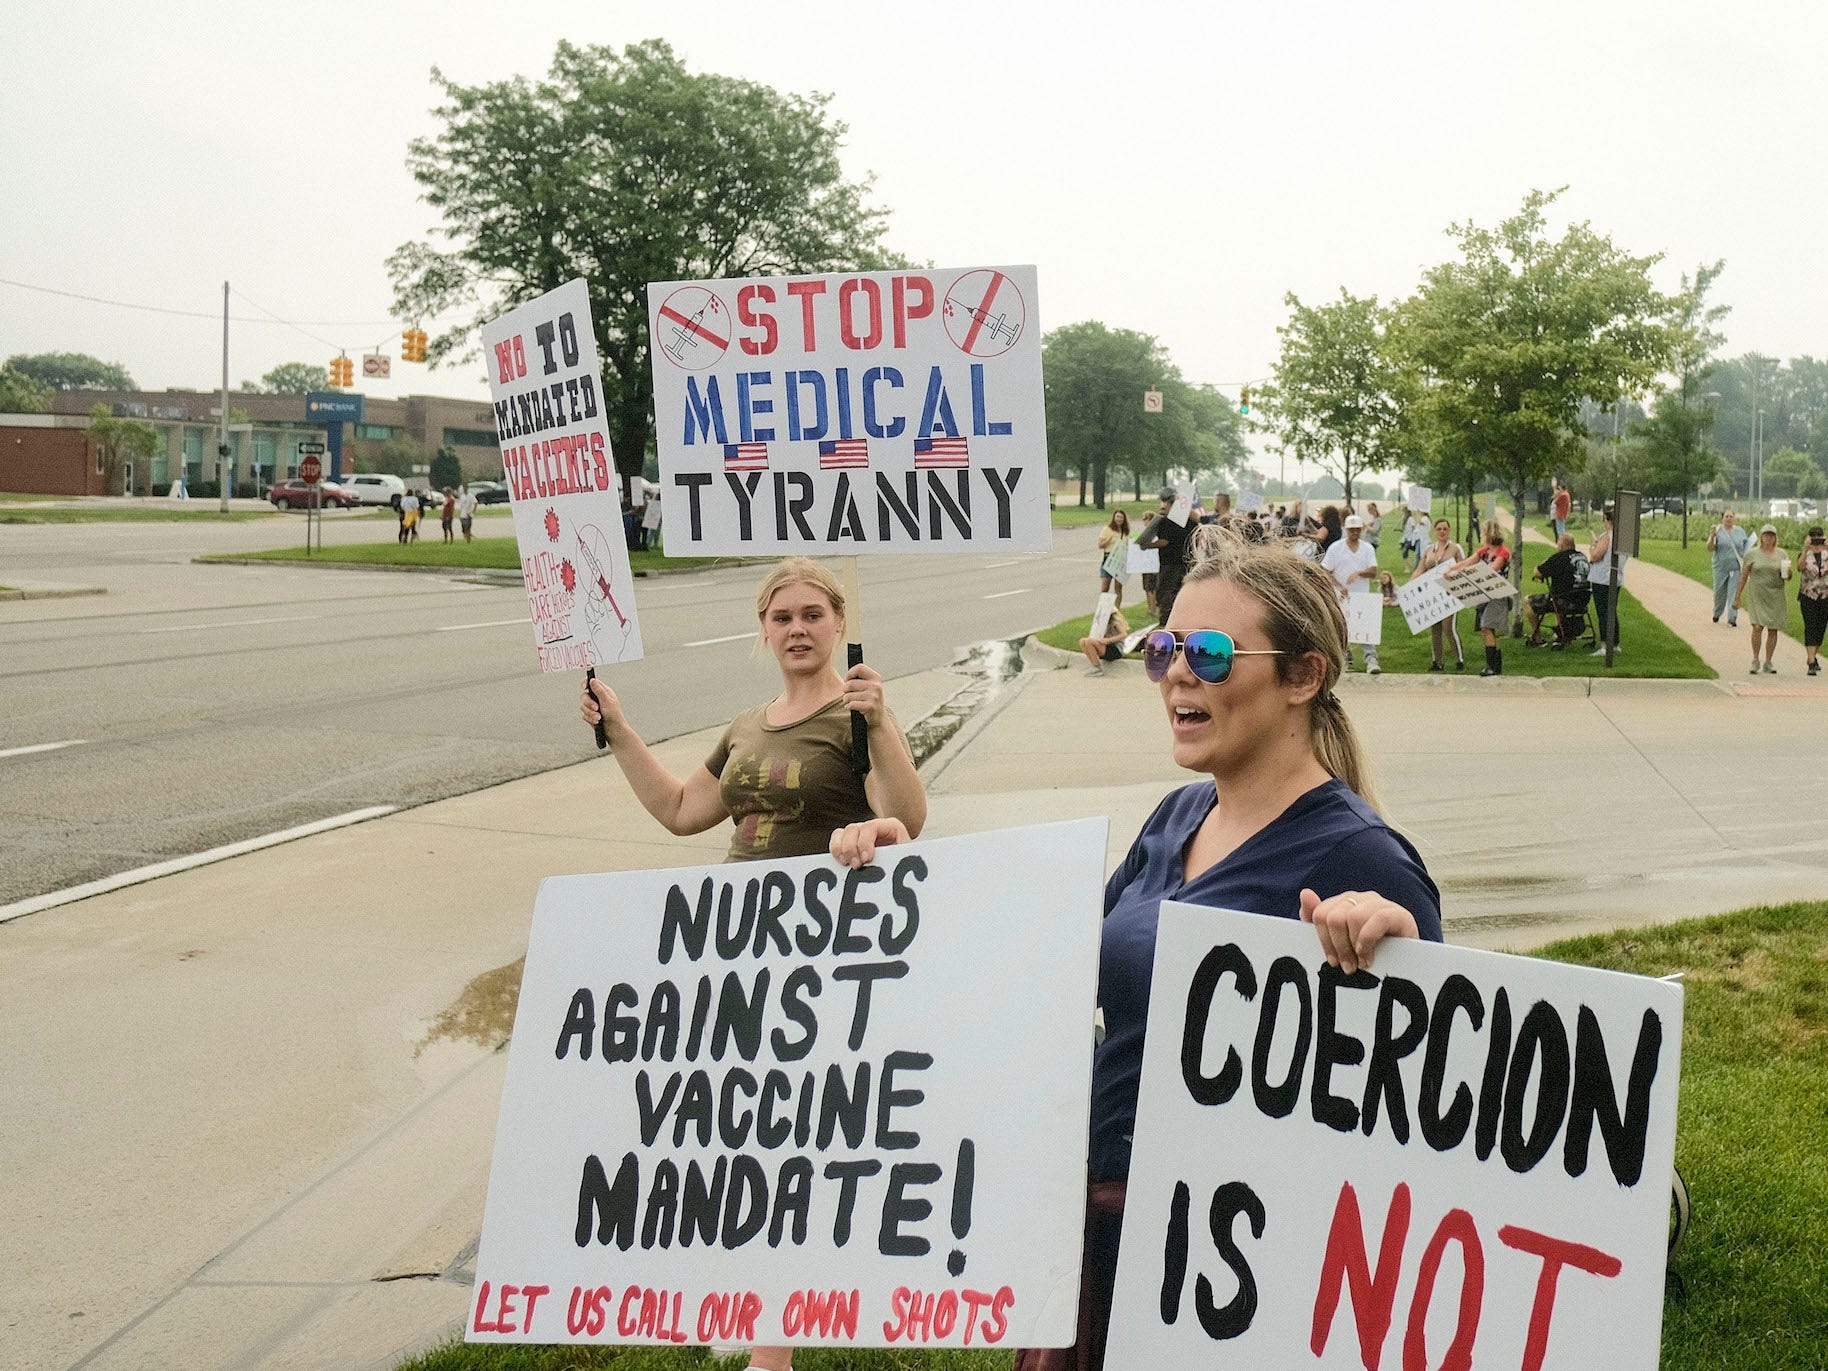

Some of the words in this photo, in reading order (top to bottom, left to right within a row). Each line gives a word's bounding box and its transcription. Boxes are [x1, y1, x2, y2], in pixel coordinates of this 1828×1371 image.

[495, 334, 526, 384] NO
[535, 311, 580, 376] TO
[737, 276, 934, 356] STOP
[495, 374, 598, 441] MANDATED
[684, 364, 1013, 445] MEDICAL
[302, 463, 321, 476] STOP
[504, 431, 610, 501] VACCINES
[675, 467, 1023, 542] TYRANNY
[529, 593, 552, 625] CARE
[542, 614, 571, 641] AGAINST
[537, 646, 562, 673] FORCED
[658, 855, 928, 965] NURSES
[556, 960, 910, 1063] AGAINST
[635, 1051, 934, 1152] VACCINE
[1181, 943, 1663, 1189] COERCION
[575, 1138, 976, 1277] MANDATE!
[473, 1281, 550, 1334] LET
[567, 1286, 613, 1338] US
[616, 1284, 687, 1343] CALL
[699, 1291, 763, 1343] OUR
[783, 1290, 860, 1340] OWN
[883, 1286, 1015, 1344] SHOTS
[1160, 1180, 1266, 1341] IS
[1310, 1181, 1622, 1371] NOT
